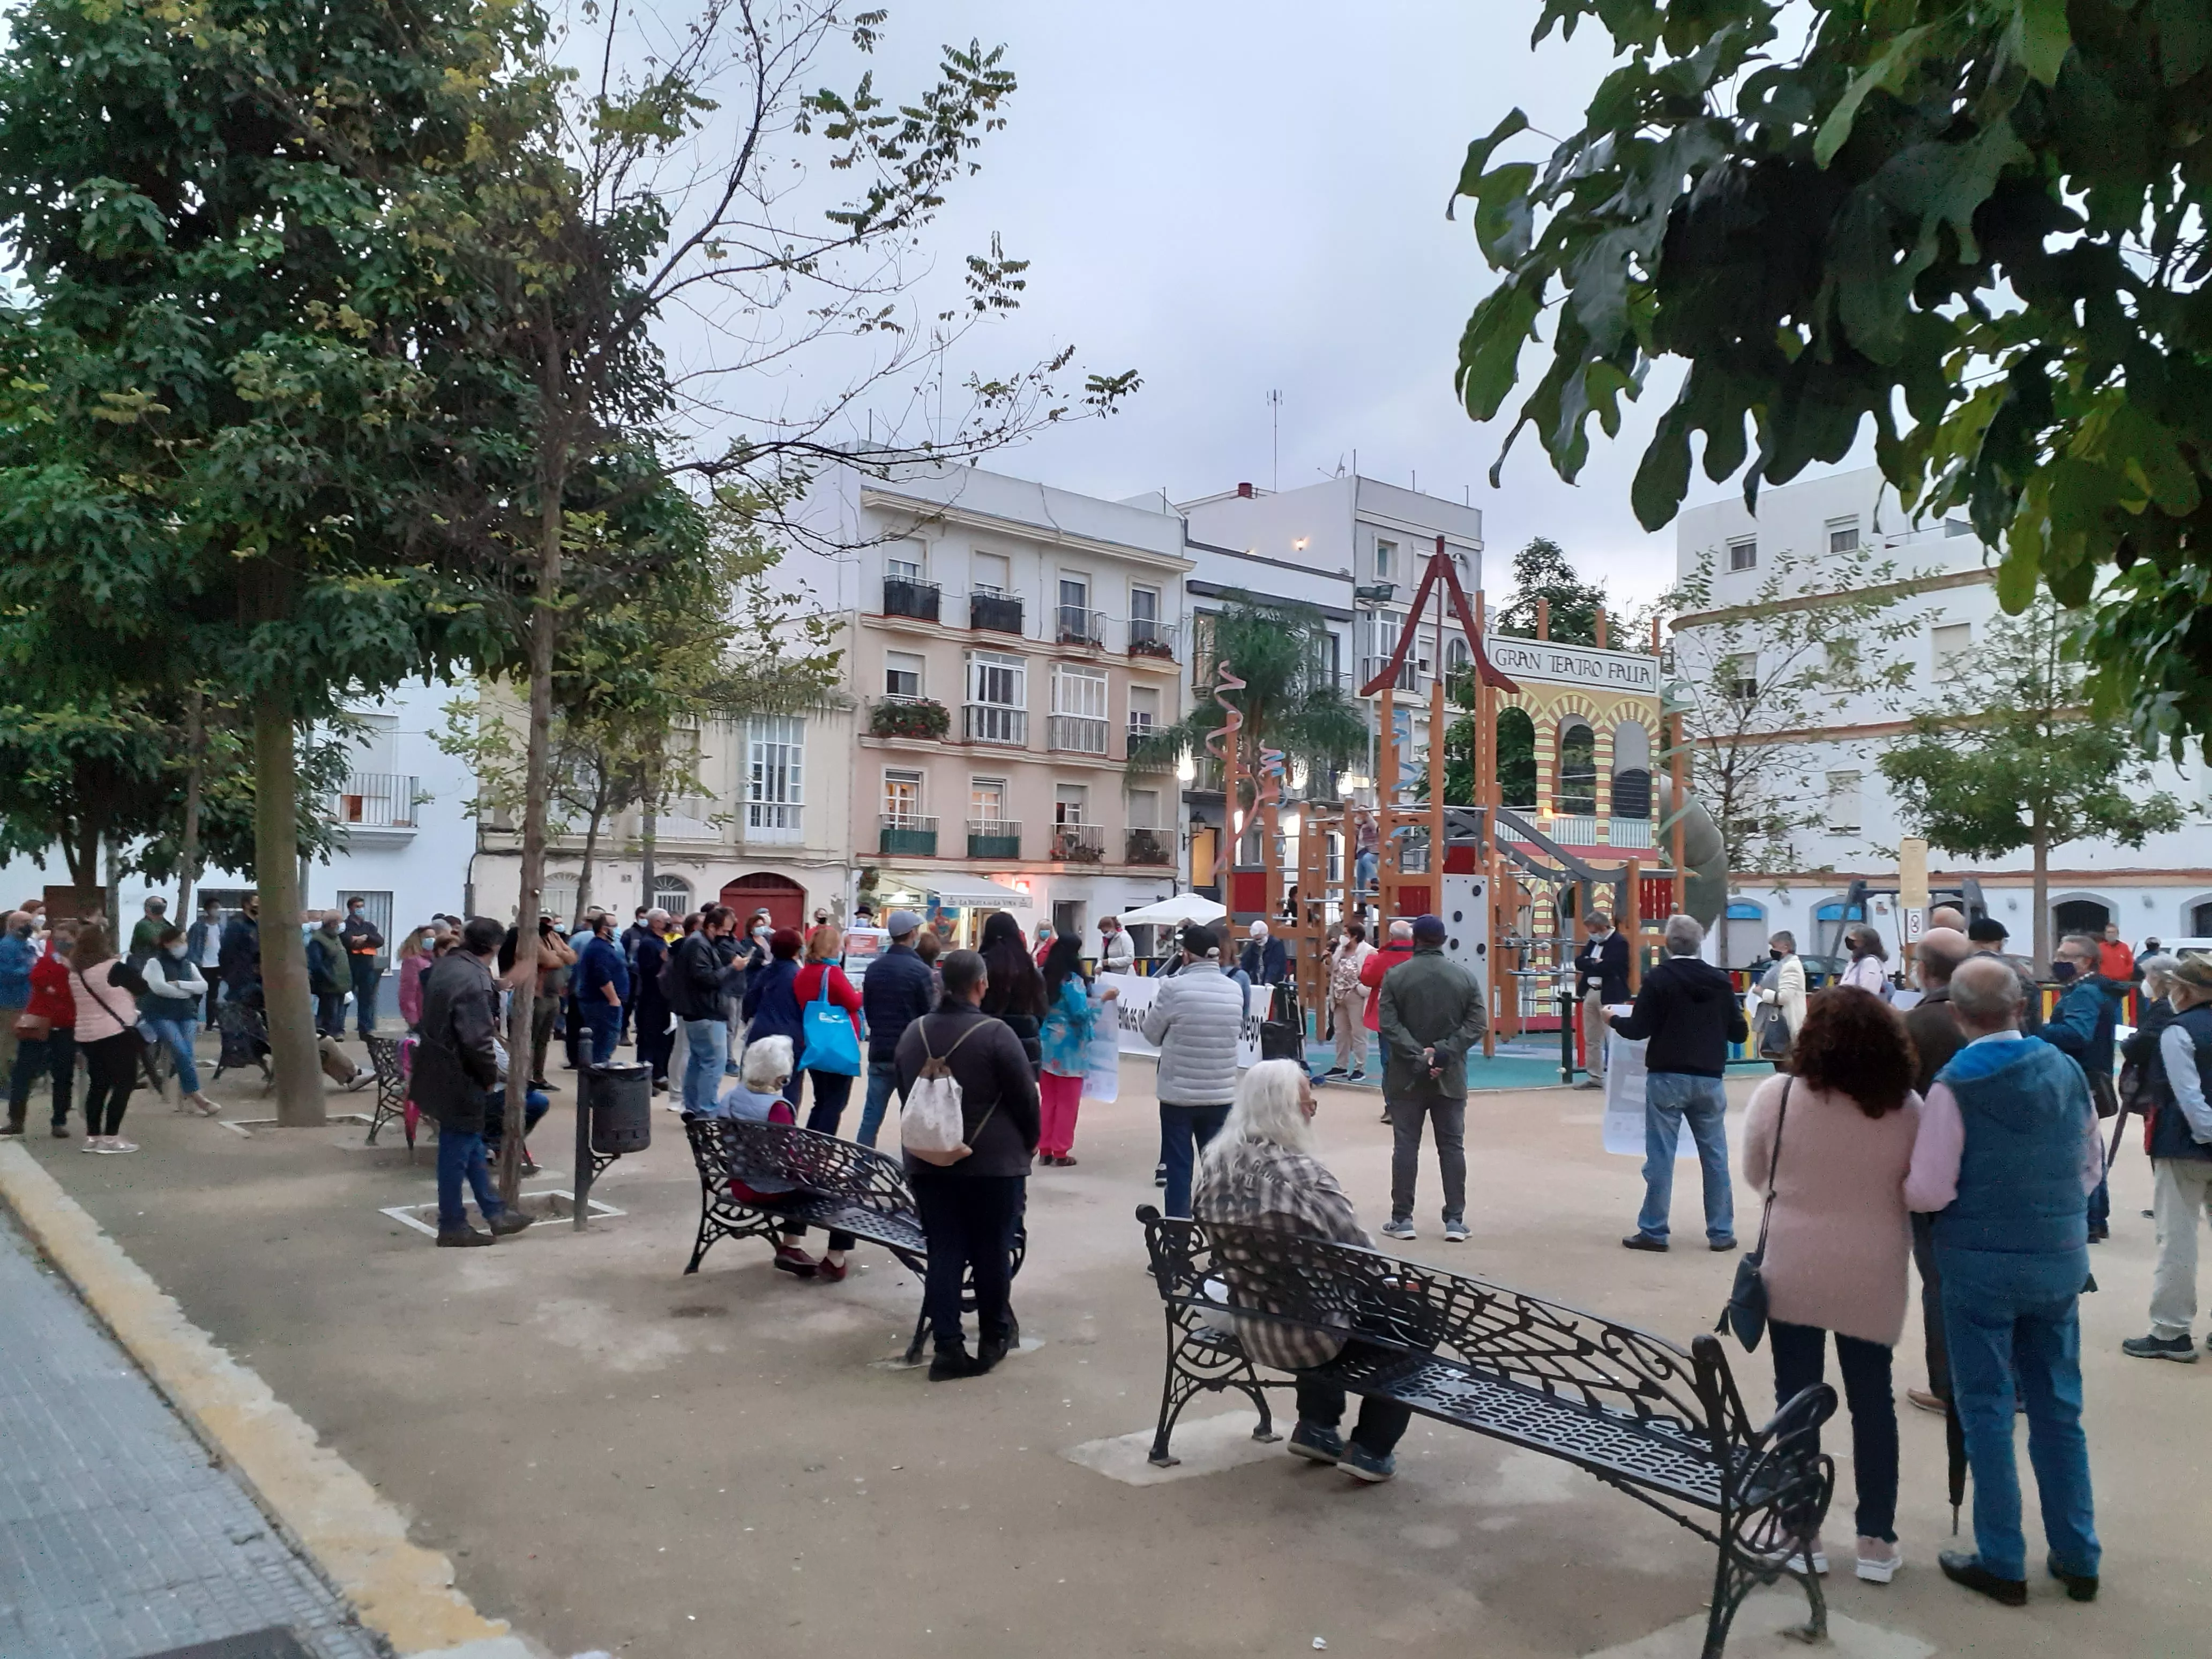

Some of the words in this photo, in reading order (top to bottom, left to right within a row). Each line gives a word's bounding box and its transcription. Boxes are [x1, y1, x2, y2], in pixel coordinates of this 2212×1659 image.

[1495, 648, 1541, 669] GRAN
[1548, 655, 1603, 677] TEATRO
[1608, 662, 1651, 684] FALLA
